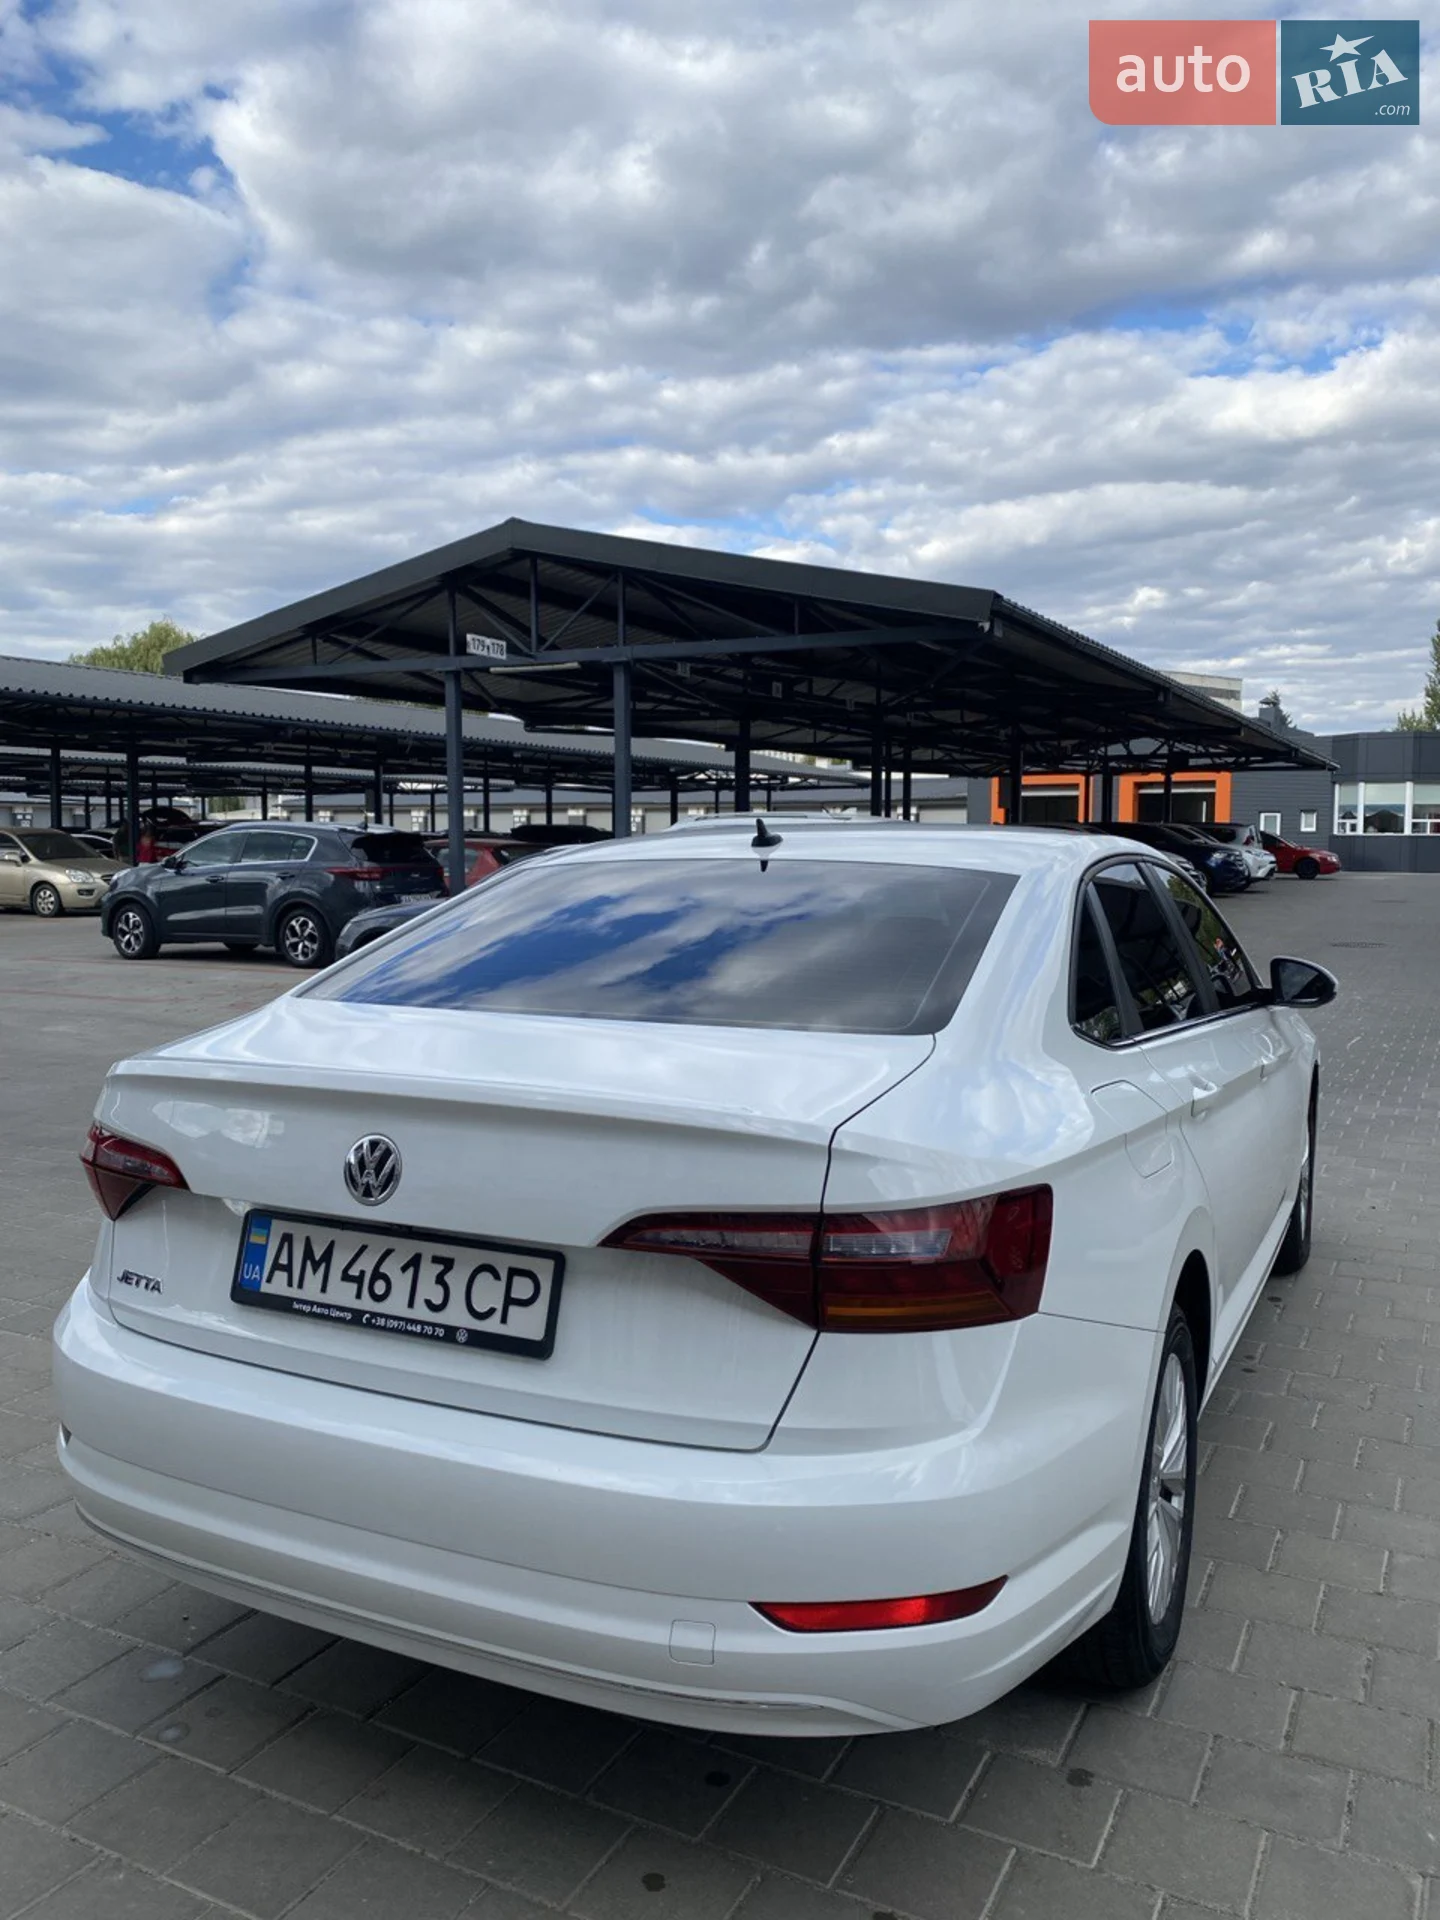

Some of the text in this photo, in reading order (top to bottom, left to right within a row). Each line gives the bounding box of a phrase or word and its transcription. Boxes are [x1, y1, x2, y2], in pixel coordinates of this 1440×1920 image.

[116, 1269, 163, 1295] JETTA
[243, 1264, 261, 1281] UA
[266, 1233, 542, 1325] AM 4613 CP
[386, 1318, 406, 1331] (097)
[422, 1325, 433, 1335] 70
[434, 1327, 445, 1337] 70
